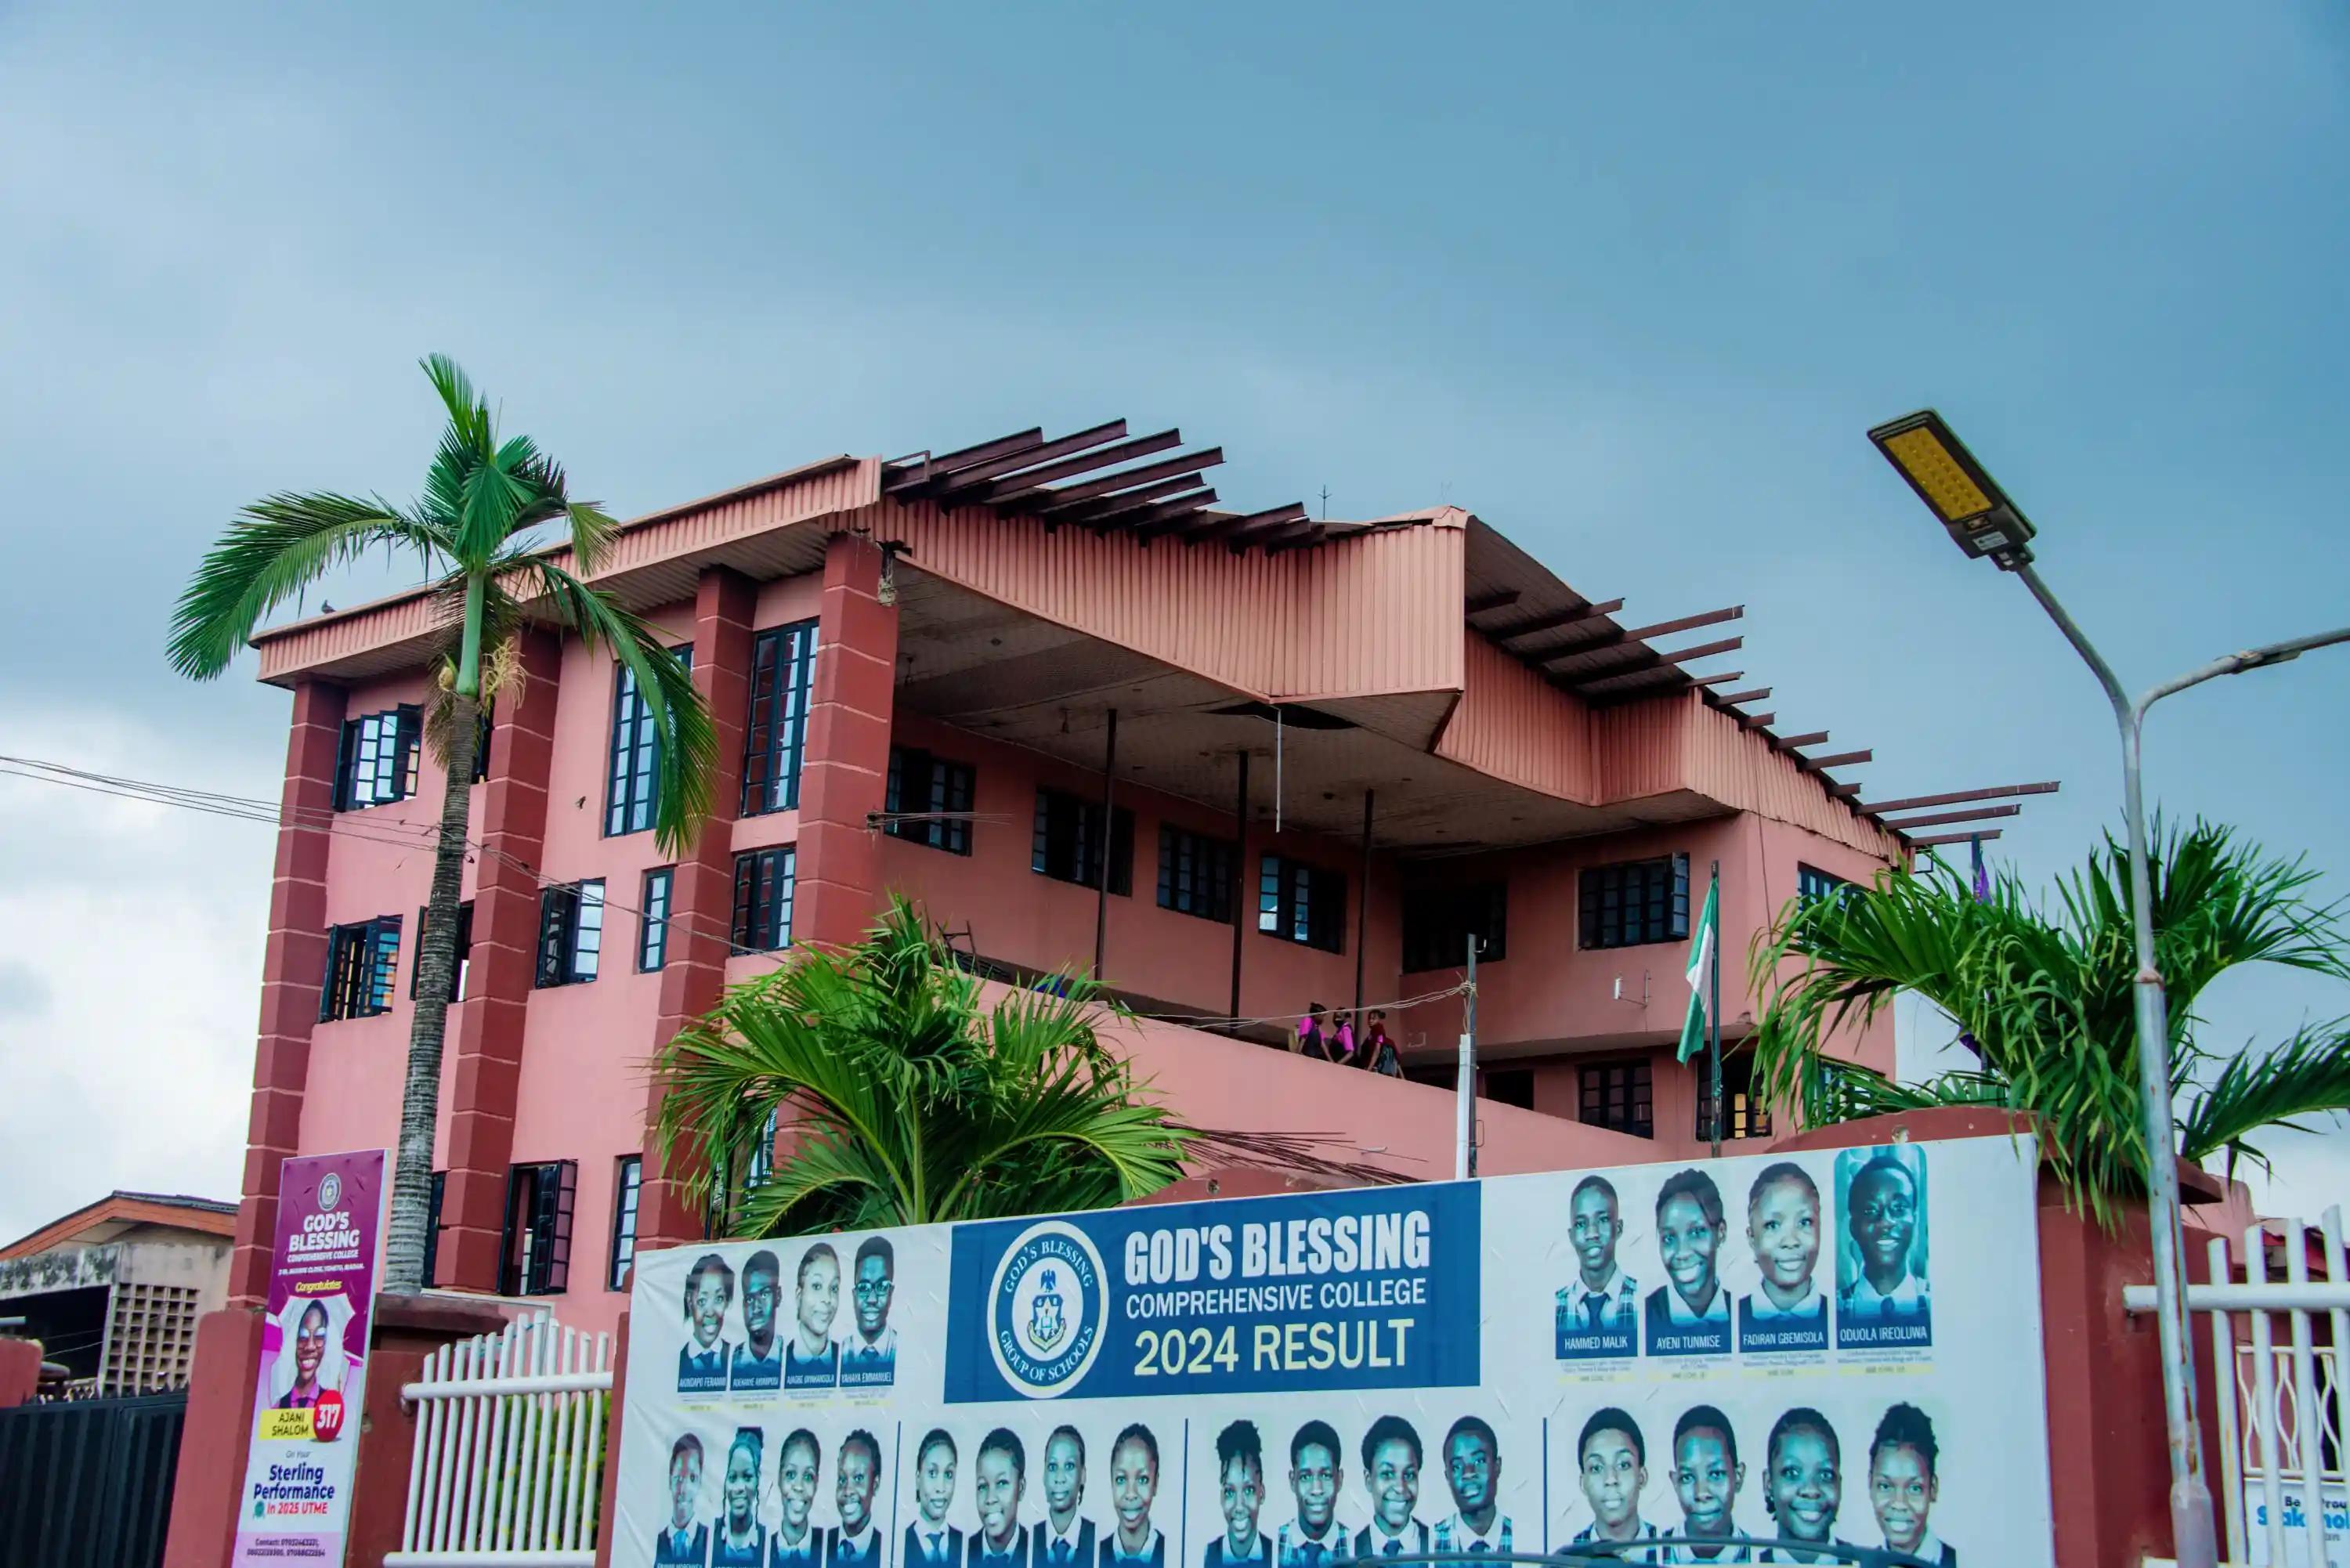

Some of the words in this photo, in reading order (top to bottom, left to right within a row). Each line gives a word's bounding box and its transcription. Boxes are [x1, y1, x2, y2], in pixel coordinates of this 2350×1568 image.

[303, 1212, 349, 1232] GOD'S
[289, 1230, 360, 1252] BLESSING
[1125, 1224, 1233, 1285] GOD'S
[1242, 1210, 1430, 1278] BLESSING
[334, 1249, 359, 1259] COLLEGE
[1005, 1246, 1037, 1293] GOD'S
[1042, 1240, 1094, 1287] BLESSING
[1126, 1283, 1313, 1319] COMPREHENSIVE
[1320, 1277, 1426, 1309] COLLEGE
[1564, 1336, 1600, 1350] HAMMED
[1602, 1335, 1628, 1349] MALIK
[1657, 1336, 1681, 1349] AYENI
[1682, 1335, 1721, 1348] TUNMISE
[1744, 1333, 1777, 1346] FADIRAN
[1778, 1331, 1824, 1344] GBEMISOLA
[1840, 1328, 1878, 1342] ODUOLA
[1880, 1326, 1928, 1341] IREOLUWA
[1000, 1330, 1029, 1375] GROUP
[1029, 1367, 1045, 1382] OF
[1048, 1326, 1093, 1381] SCHOOLS
[1133, 1325, 1238, 1376] 2024
[1253, 1317, 1414, 1371] RESULT
[279, 1412, 305, 1423] AJANI
[316, 1404, 341, 1429] 317
[272, 1424, 309, 1436] SHALOM
[269, 1462, 324, 1484] Sterling
[254, 1481, 334, 1499] Performance
[278, 1502, 298, 1514] 2025
[302, 1502, 327, 1514] UTME
